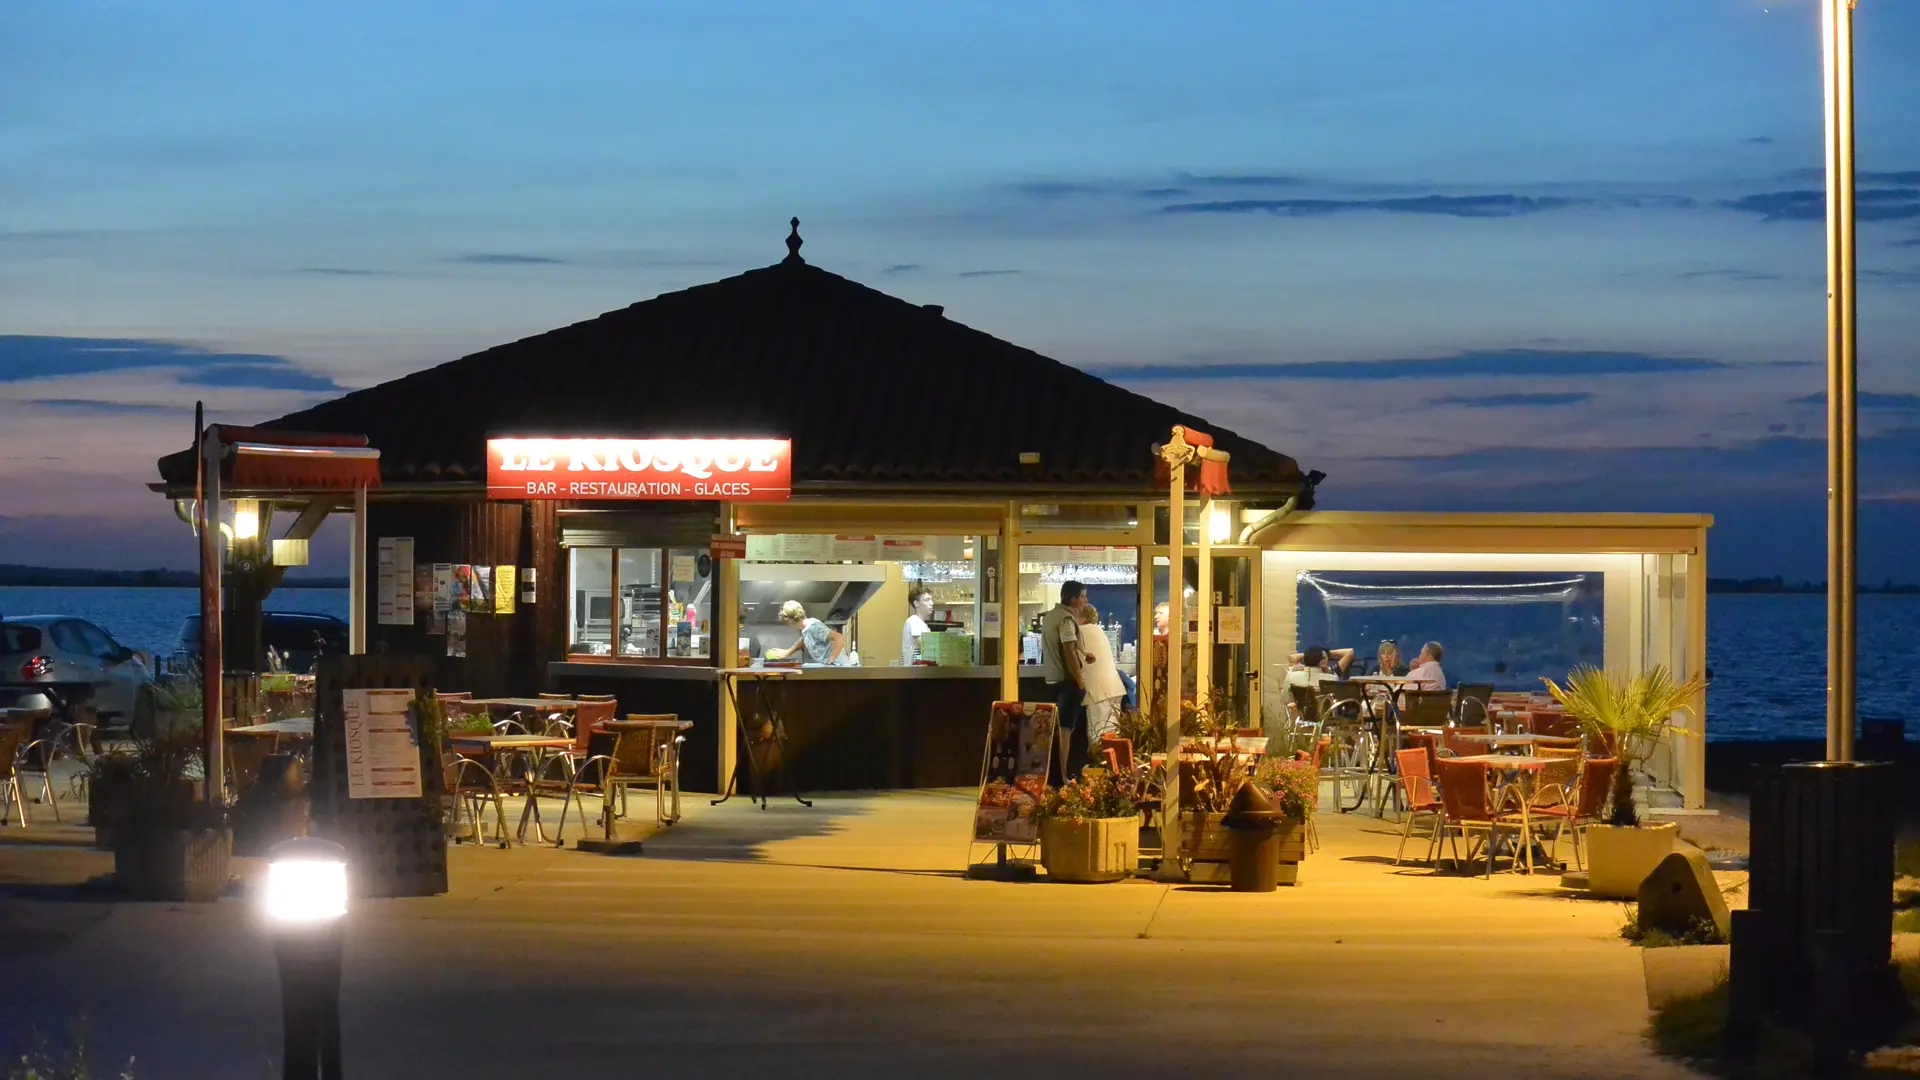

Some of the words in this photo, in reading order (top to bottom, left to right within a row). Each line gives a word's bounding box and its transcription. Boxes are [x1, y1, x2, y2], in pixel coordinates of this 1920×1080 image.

[526, 482, 557, 495] BAR
[569, 482, 681, 496] RESTAURATION
[694, 482, 751, 496] GLACES
[346, 700, 363, 765] KIOSQUE
[351, 768, 365, 786] LE
